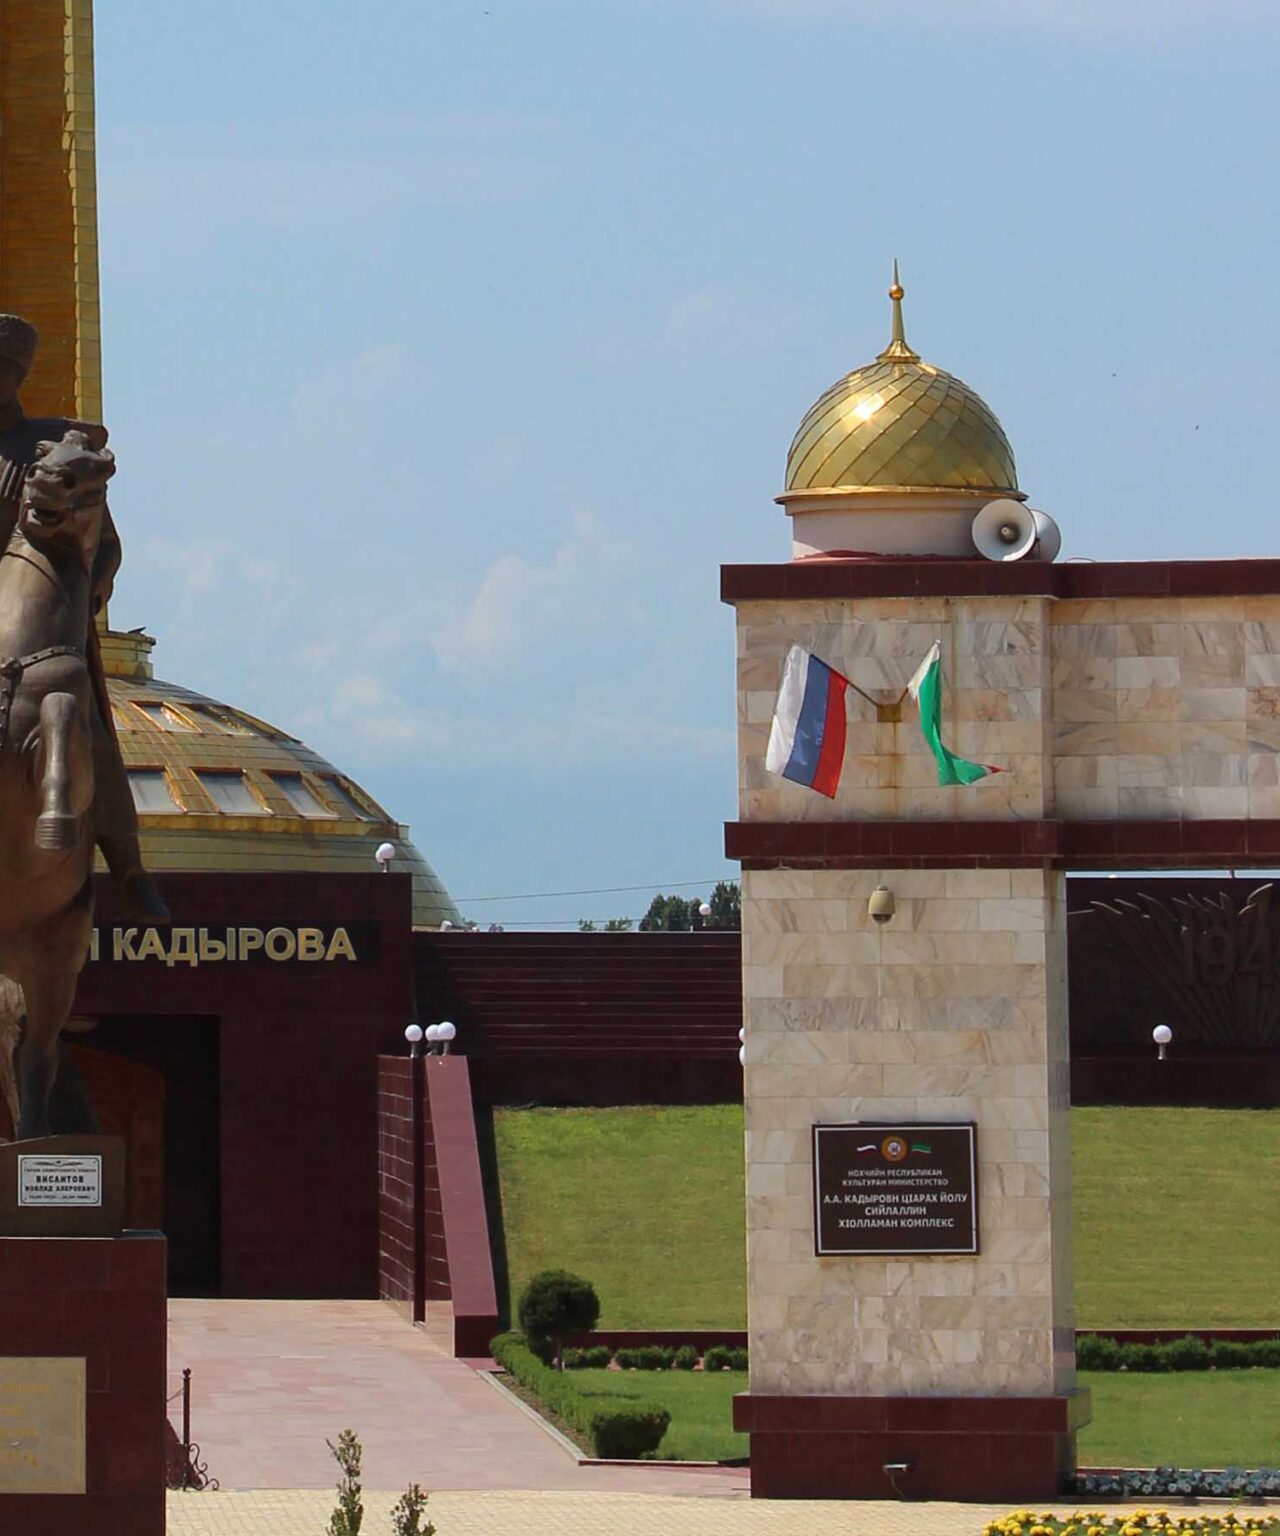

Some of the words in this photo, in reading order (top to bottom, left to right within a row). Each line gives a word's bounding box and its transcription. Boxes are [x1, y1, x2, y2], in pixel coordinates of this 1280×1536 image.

[112, 927, 357, 967] КАДЫРОВА
[887, 1168, 942, 1176] РЕСПУБЛИКАН
[842, 1178, 886, 1187] КУЛЬТУРАН
[888, 1178, 948, 1186] МИНИСТЕРСТВО
[824, 1195, 842, 1204] А.А.
[940, 1193, 967, 1202] ЙОЛУ
[865, 1205, 927, 1216] СИЙЛАЛЛИН
[900, 1218, 955, 1228] КОМПЛЕКС
